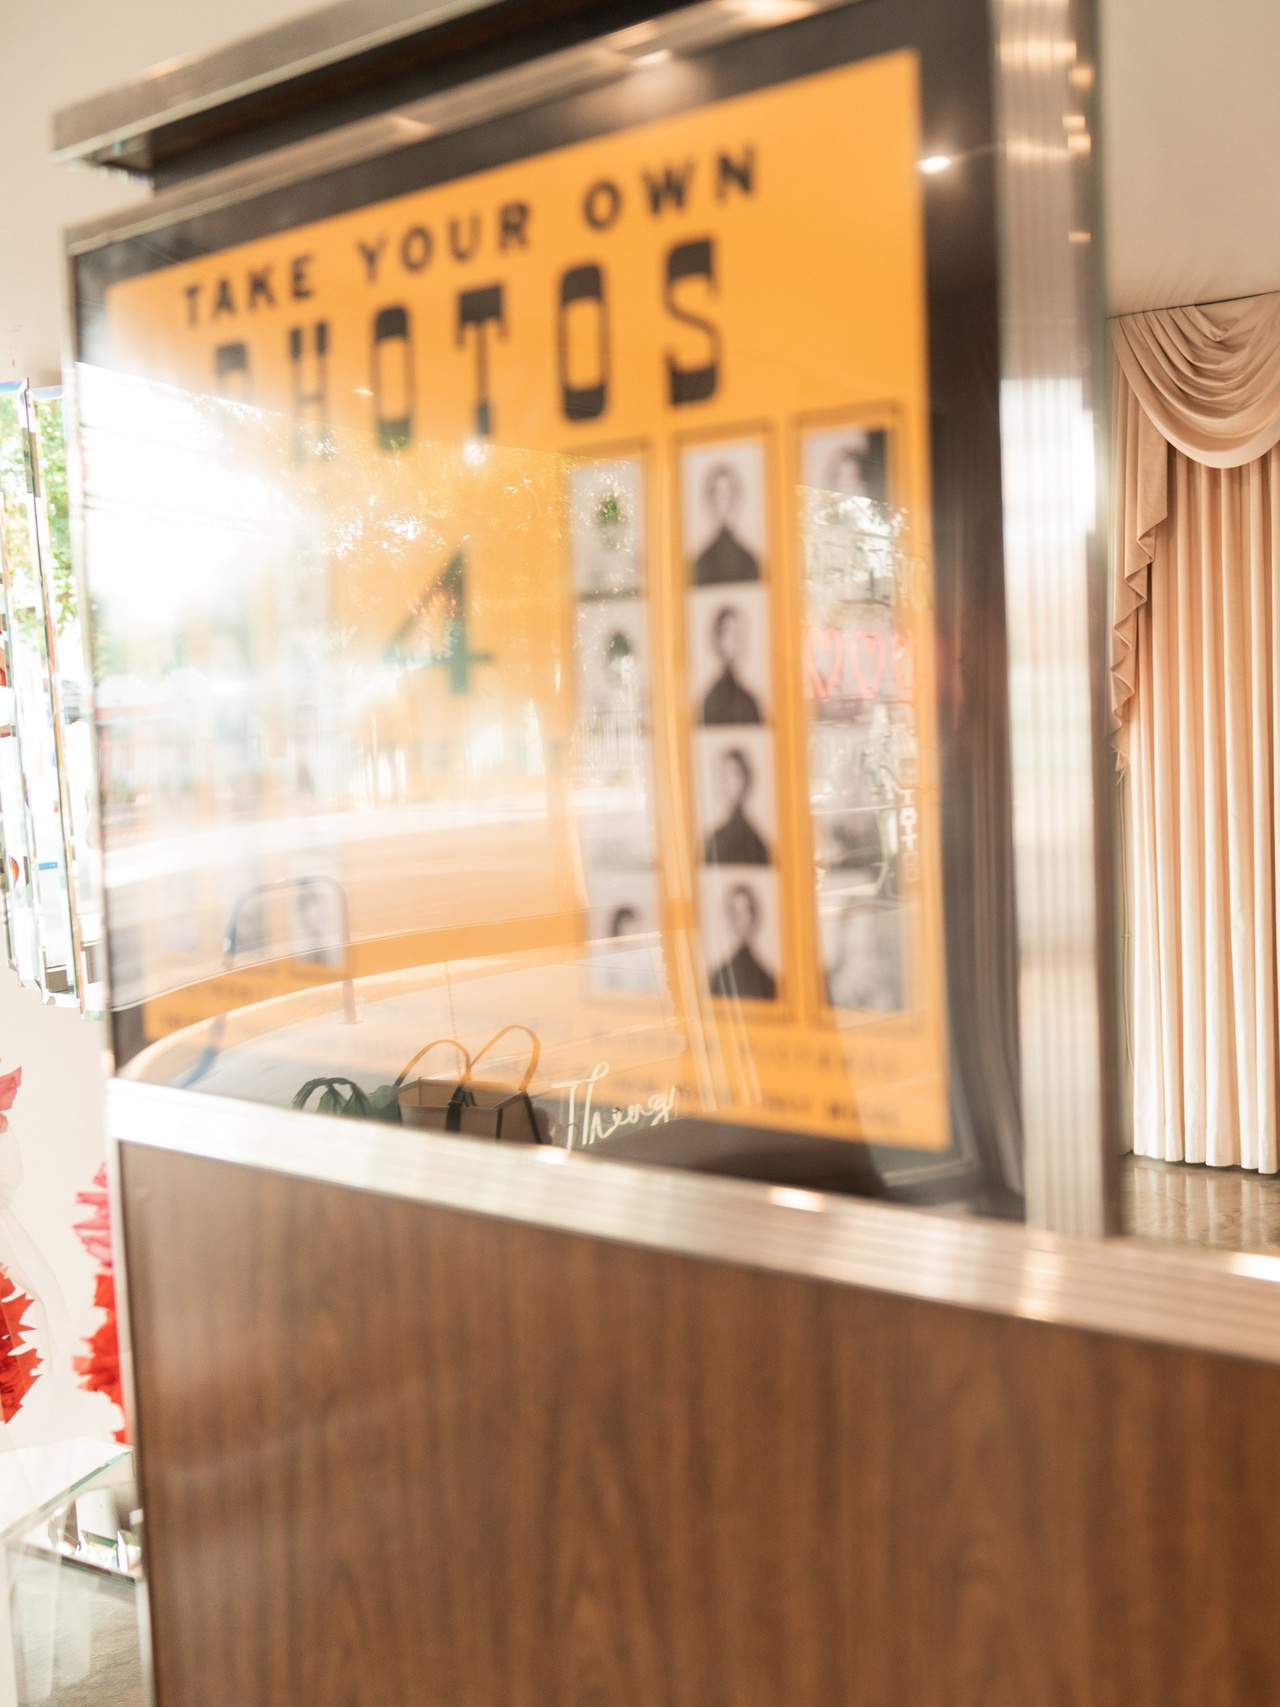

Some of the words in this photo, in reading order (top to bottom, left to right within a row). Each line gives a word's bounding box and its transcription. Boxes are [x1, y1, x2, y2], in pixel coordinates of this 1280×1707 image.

[185, 255, 313, 328] TAKE
[357, 202, 528, 283] YOUR
[583, 142, 754, 232] OWN
[383, 548, 496, 694] 4
